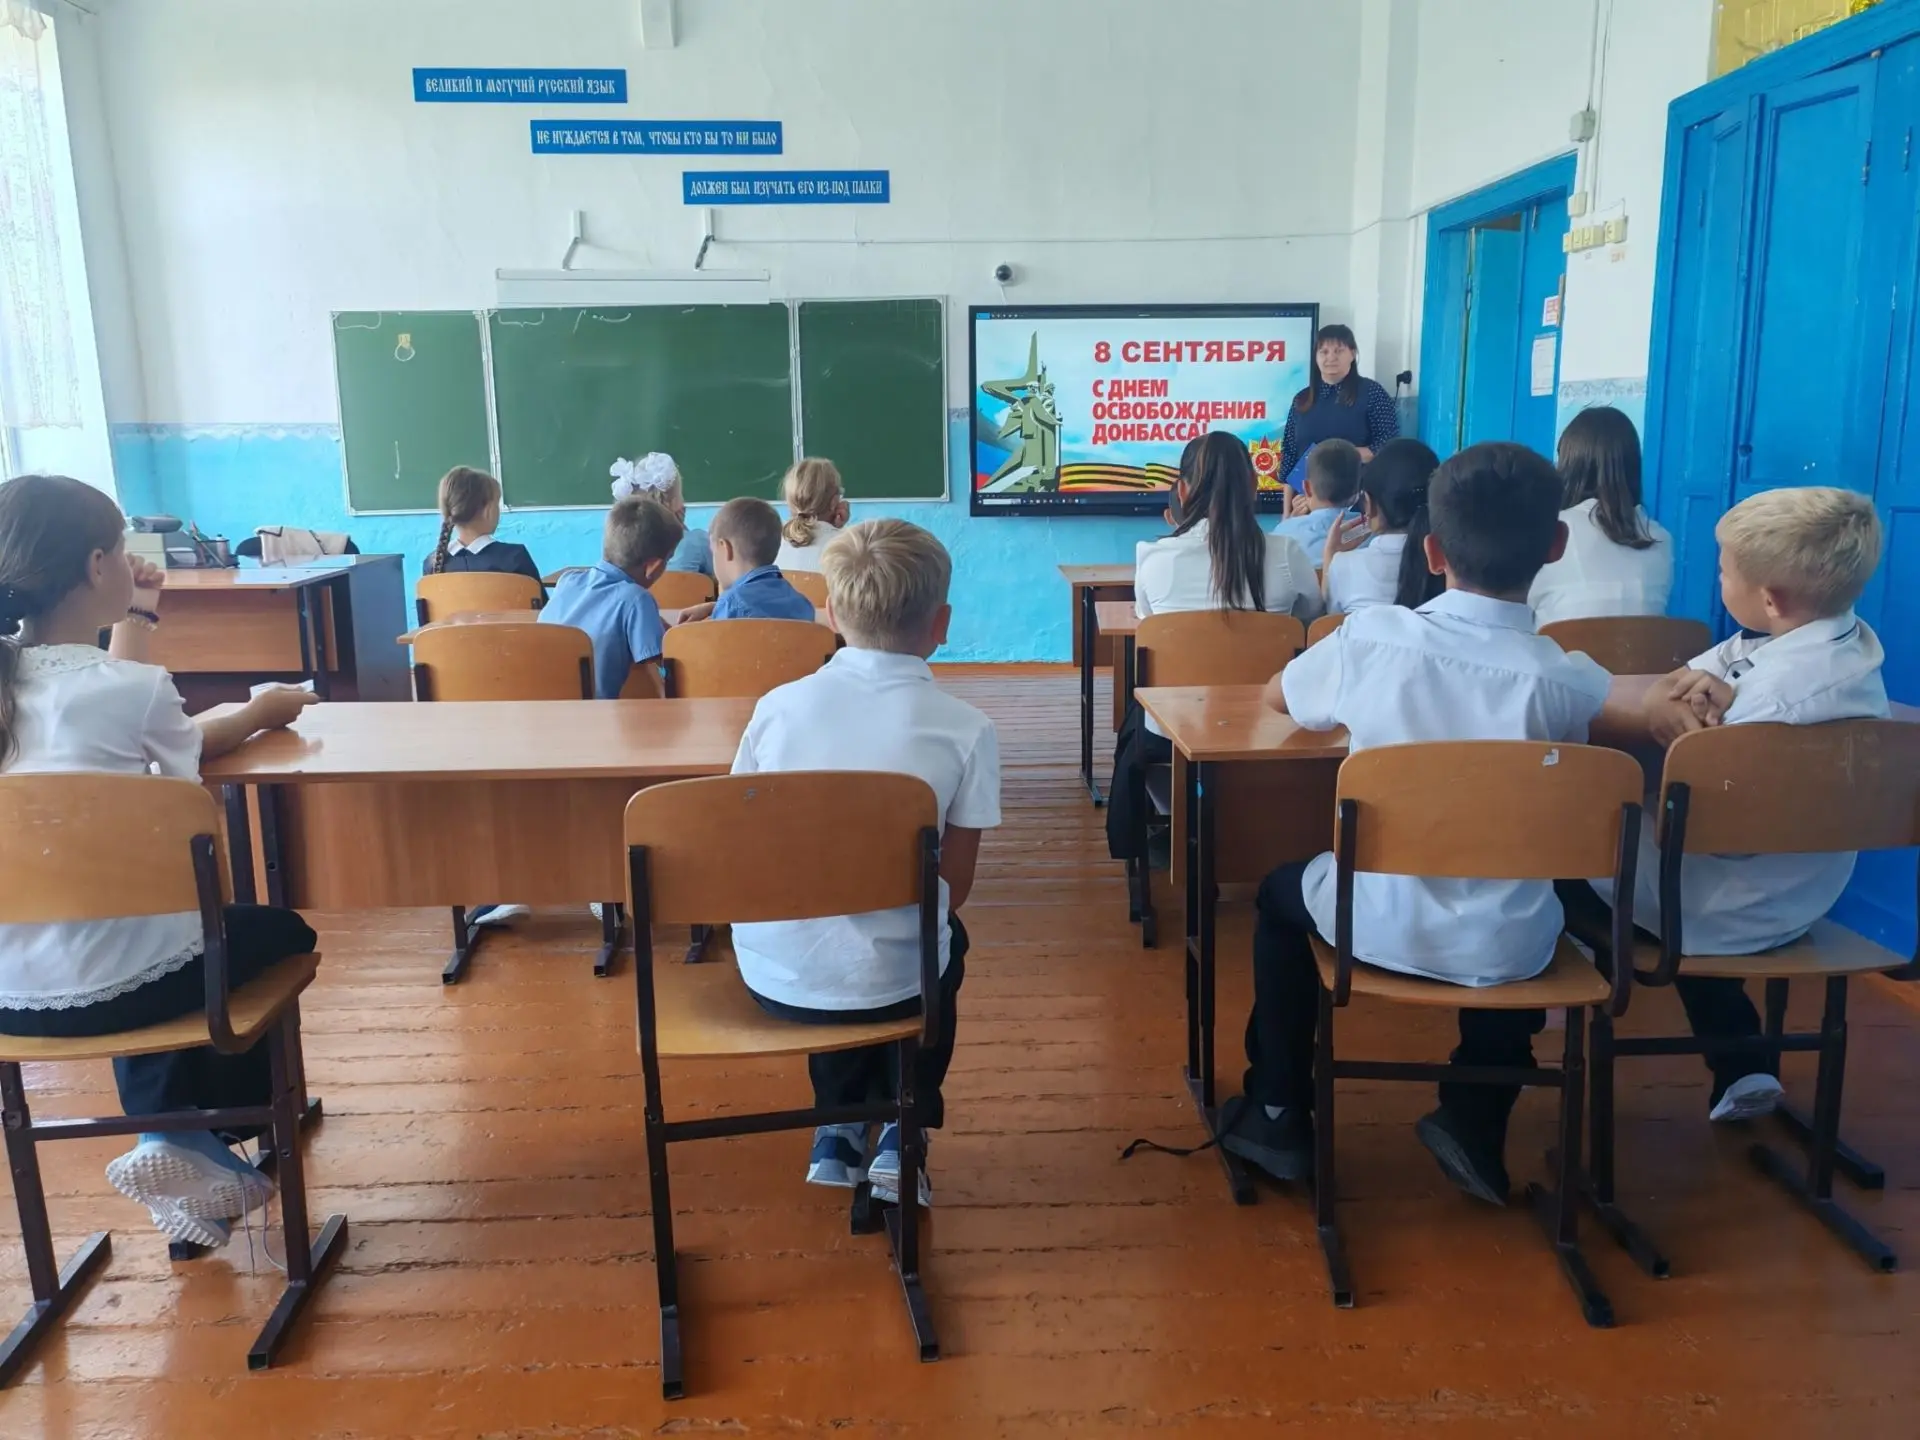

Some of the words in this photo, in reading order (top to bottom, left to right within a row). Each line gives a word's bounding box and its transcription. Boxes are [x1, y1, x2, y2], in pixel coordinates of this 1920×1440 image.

[425, 76, 473, 93] ВЕЛИКИЙ
[475, 79, 483, 93] И
[486, 76, 535, 97] МОГУЧИЙ
[538, 77, 584, 96] РУССКИЙ
[587, 79, 615, 95] ЯЗЫК
[536, 130, 550, 144] НЕ
[552, 130, 610, 148] НУЖДАЕТСЯ
[613, 130, 619, 144] В
[622, 131, 645, 146] ТОМ,
[649, 131, 681, 145] ЧТОБЫ
[683, 131, 702, 145] КТО
[705, 131, 718, 145] БЫ
[721, 131, 733, 145] ТО
[736, 131, 749, 145] НИ
[752, 131, 777, 146] БЫЛО
[690, 181, 728, 197] ДОЛЖЕН
[731, 181, 750, 194] БЫЛ
[753, 181, 795, 198] ИЗУЧАТЬ
[798, 181, 815, 194] ЕГО
[817, 180, 850, 196] ИЗ-ПОД
[852, 180, 883, 194] ПАЛКИ
[1094, 341, 1111, 363] 8
[1122, 340, 1287, 363] СЕНТЯБРЯ
[1092, 379, 1104, 398] С
[1107, 379, 1168, 400] ДНЕМ
[1092, 401, 1266, 423] ОСВОБОЖДЕНИЯ
